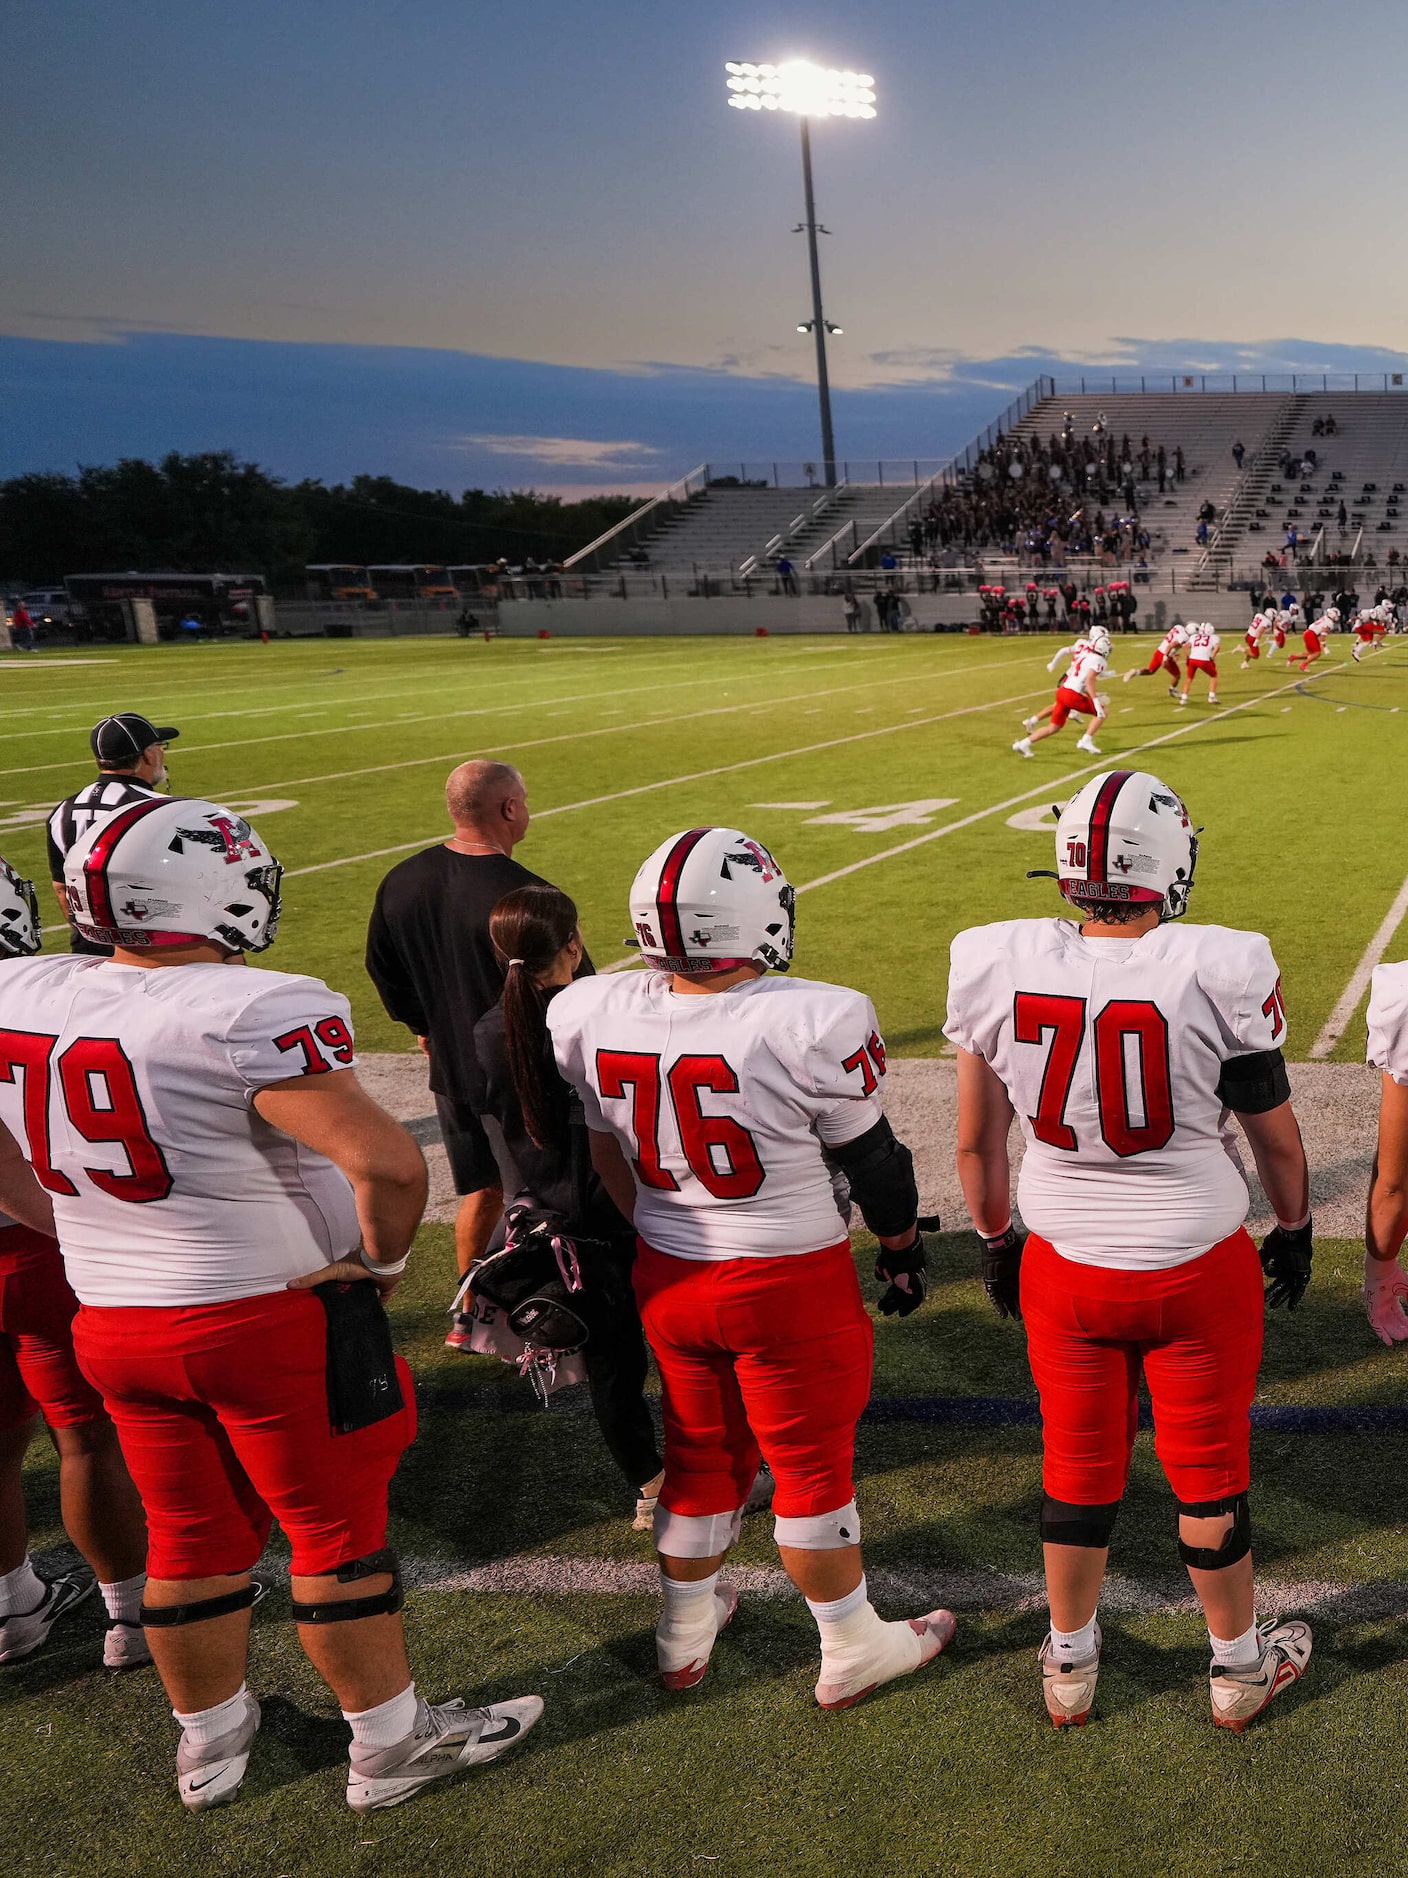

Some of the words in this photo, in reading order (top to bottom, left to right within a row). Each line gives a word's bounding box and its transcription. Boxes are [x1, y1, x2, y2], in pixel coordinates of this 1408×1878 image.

[1193, 634, 1211, 647] 23
[1067, 842, 1087, 868] 70
[1069, 879, 1130, 900] EAGLES
[76, 923, 152, 947] EAGLES
[635, 923, 658, 948] 76
[649, 955, 713, 973] EAGLES
[271, 1014, 355, 1077] 79
[840, 1029, 888, 1098] 76
[1013, 990, 1177, 1159] 70
[0, 1028, 176, 1204] 79
[595, 1048, 767, 1200] 76
